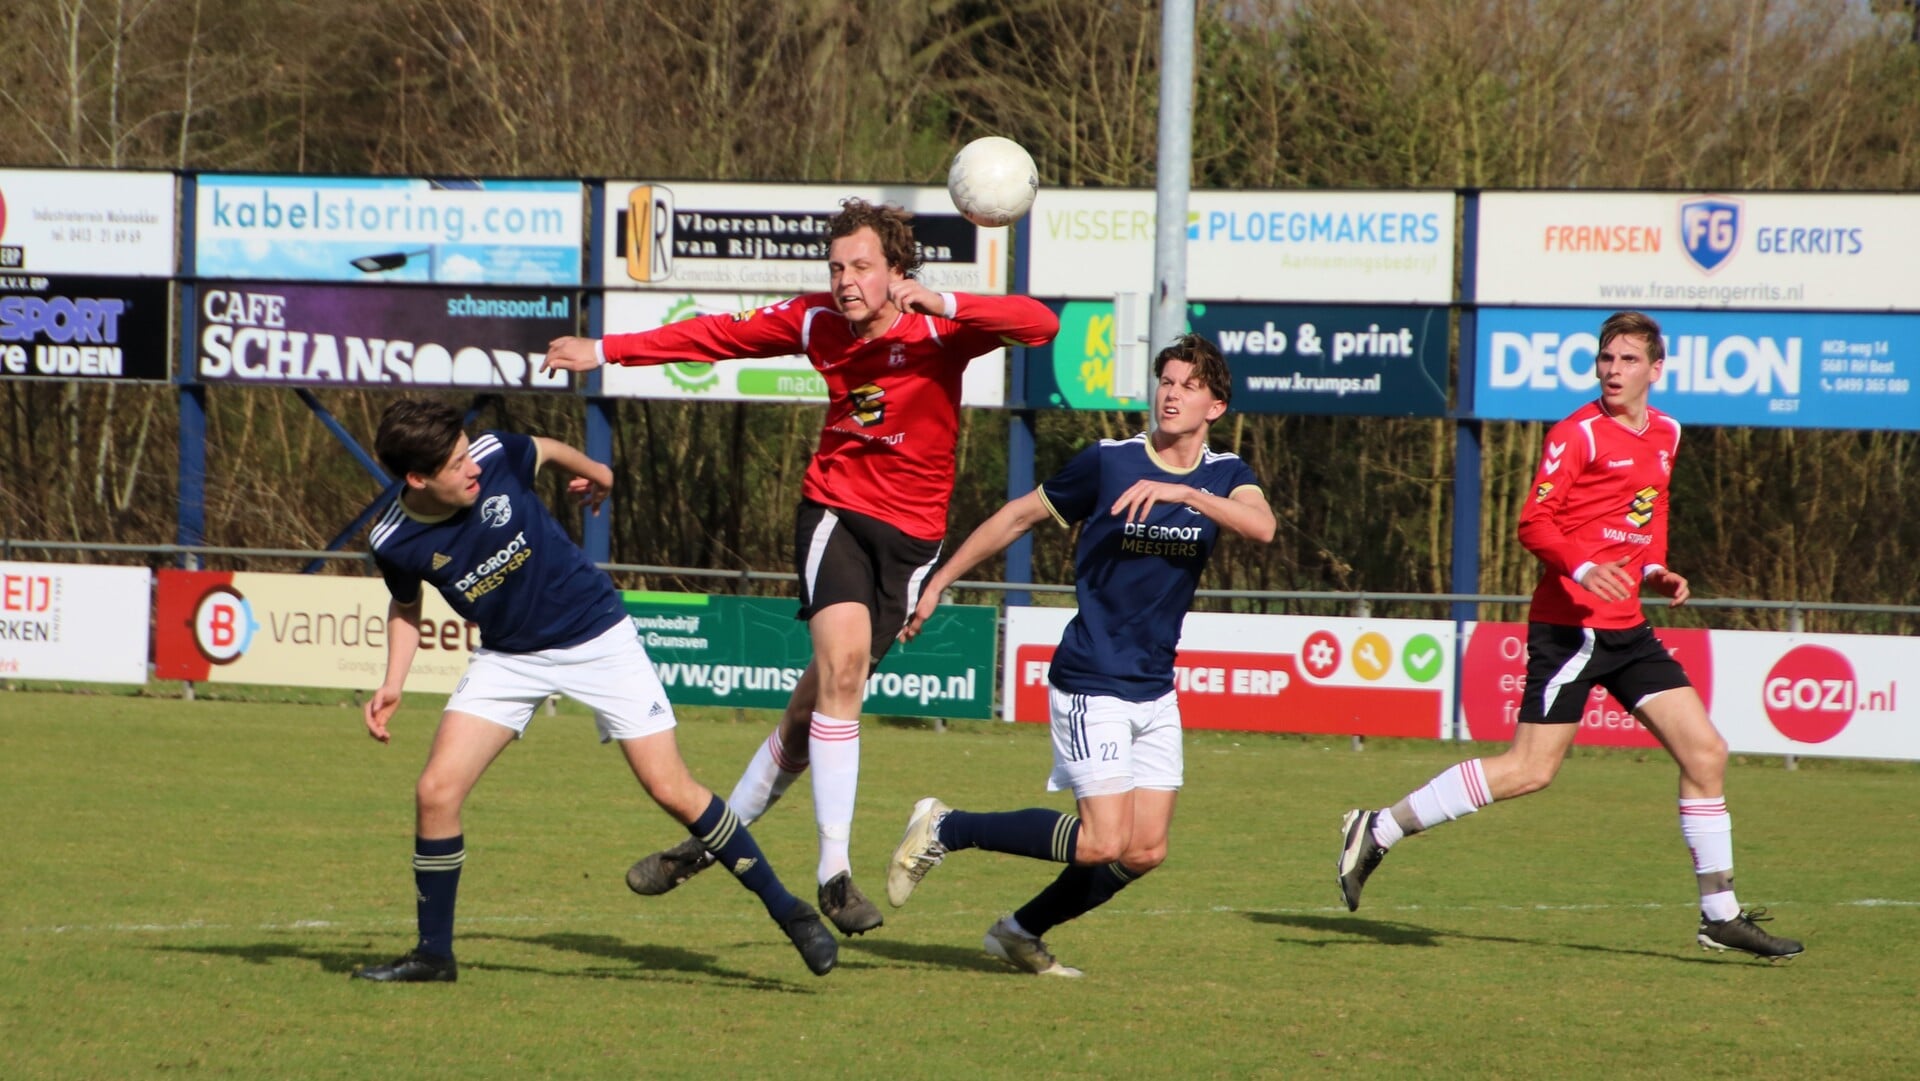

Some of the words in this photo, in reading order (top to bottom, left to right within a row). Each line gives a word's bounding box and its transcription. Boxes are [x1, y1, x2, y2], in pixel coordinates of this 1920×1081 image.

[213, 189, 563, 240] kabelstoring.com
[1208, 211, 1439, 244] PLOEGMAKERS
[1544, 225, 1661, 253] FRANSEN
[1686, 208, 1733, 252] FG
[1756, 227, 1862, 255] GERRITS
[676, 238, 717, 254] van
[1281, 253, 1437, 274] Aannemingsbedrijf
[30, 276, 50, 290] ERP
[1599, 280, 1803, 306] www.fransengerrits.nl
[203, 289, 286, 328] CAFE
[447, 293, 569, 318] schansoord.nl
[1219, 321, 1287, 355] web
[1296, 324, 1323, 355] &
[1333, 325, 1413, 362] print
[35, 344, 122, 375] UDEN
[1489, 331, 1801, 395] DECHLON
[1870, 360, 1894, 373] Best
[1247, 372, 1381, 397] www.krumps.nl
[1770, 399, 1799, 413] BEST
[1124, 523, 1145, 536] DE
[1148, 525, 1202, 541] GROOT
[1603, 528, 1626, 542] VAN
[1121, 538, 1198, 557] MEESTERS
[455, 573, 479, 592] DE
[476, 531, 528, 577] GROOT
[464, 548, 532, 603] MEESTERS
[210, 604, 235, 646] B
[646, 631, 708, 649] Grunsven
[1232, 669, 1290, 695] ERP
[1100, 742, 1119, 761] 22
